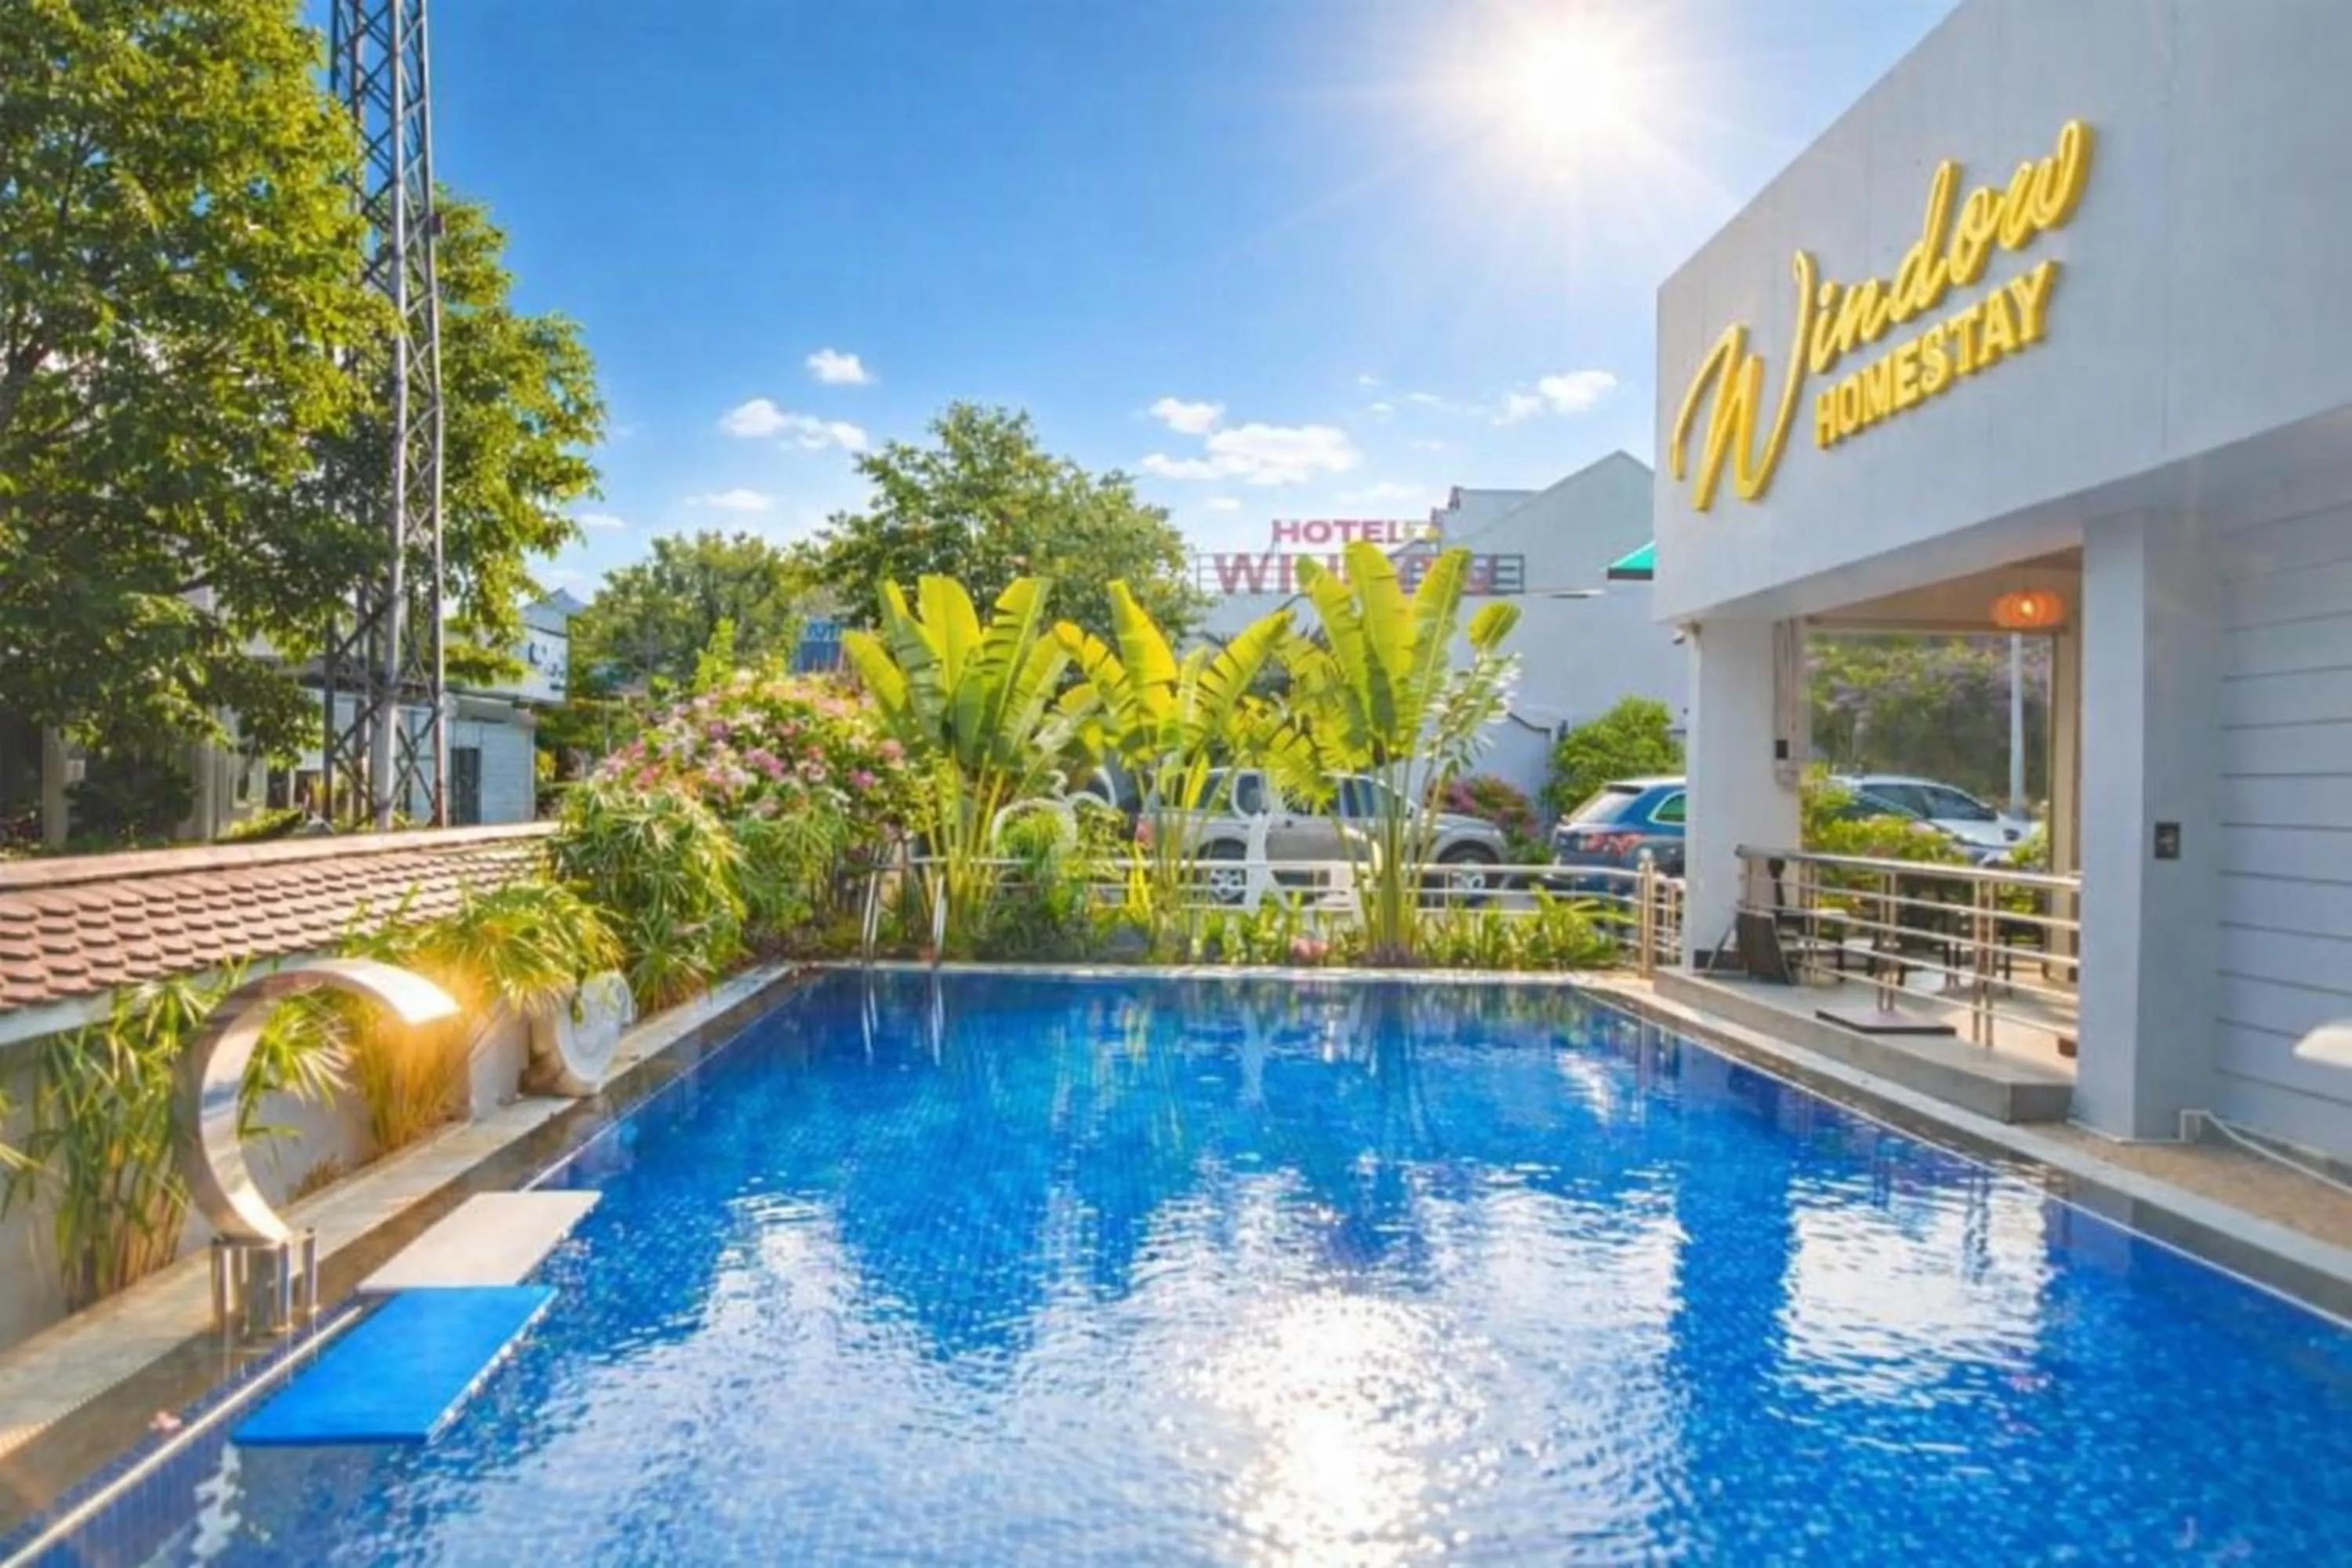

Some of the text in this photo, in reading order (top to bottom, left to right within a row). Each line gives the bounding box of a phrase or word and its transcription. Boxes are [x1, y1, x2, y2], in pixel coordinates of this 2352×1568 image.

[1671, 119, 2092, 513] Window
[1814, 259, 2062, 450] HOMESTAY
[1272, 519, 1403, 543] HOTEL
